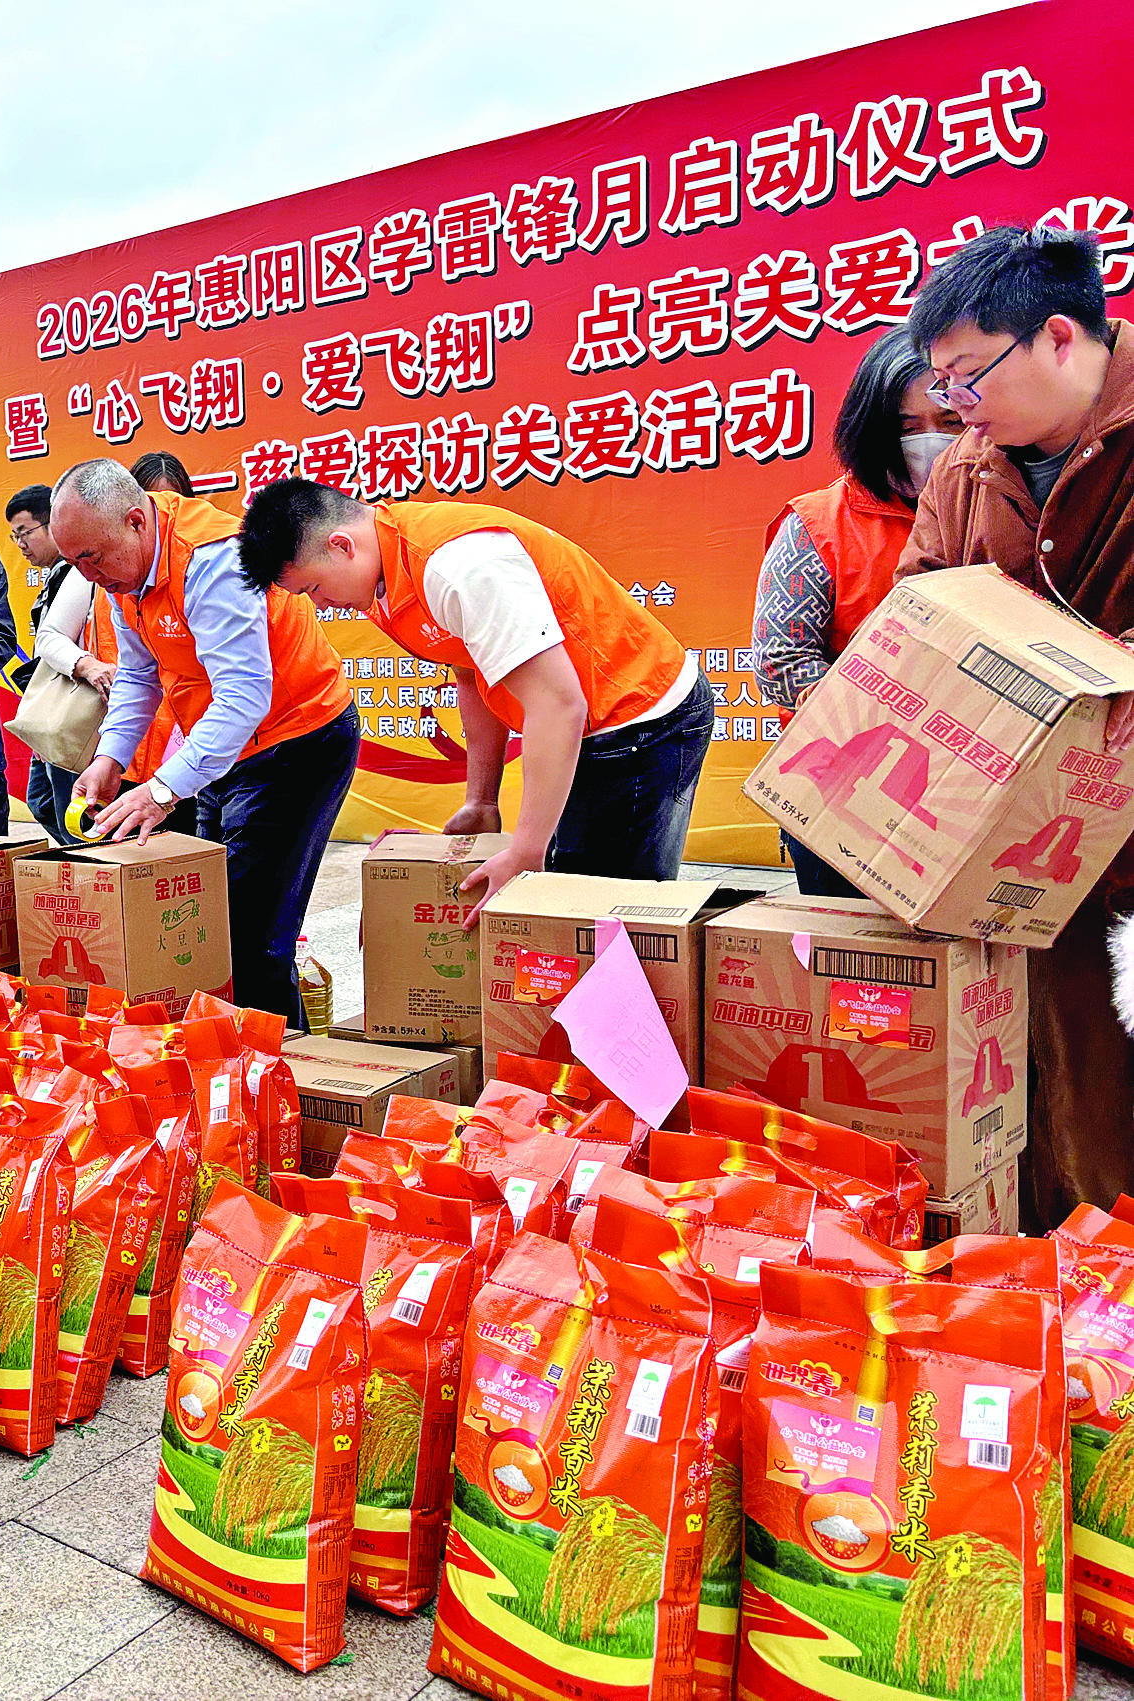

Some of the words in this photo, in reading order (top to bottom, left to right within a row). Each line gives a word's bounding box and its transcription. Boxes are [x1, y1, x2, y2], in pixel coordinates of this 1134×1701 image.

[36, 66, 1045, 361] 2026年惠阳区学雷锋月启动仪式
[868, 630, 901, 658] 金龙鱼
[350, 685, 457, 708] 区人民政府
[840, 655, 927, 720] 加油中国
[923, 711, 1019, 784] 品质是金
[1058, 747, 1122, 781] 加油中国
[1067, 777, 1133, 810] 品质是金
[34, 894, 80, 911] 加油中国
[93, 883, 114, 893] 金龙鱼
[155, 872, 203, 902] 金龙鱼
[54, 911, 100, 929] 品质是金
[157, 926, 207, 952] 大豆油
[717, 972, 756, 989] 金龙鱼
[962, 974, 997, 1013] 加油中国
[715, 1001, 810, 1033] 加油中国
[977, 989, 1013, 1027] 品质是金
[183, 1267, 234, 1300] 世界春
[477, 1322, 540, 1354] 世界春
[218, 1300, 288, 1440] 茉莉香米
[761, 1360, 841, 1398] 世界春
[476, 1377, 541, 1413] 心飞翔公益协会
[549, 1358, 617, 1518] 茉莉香米
[780, 1425, 866, 1459] 心飞翔公益协会
[891, 1390, 940, 1564] 茉莉香米
